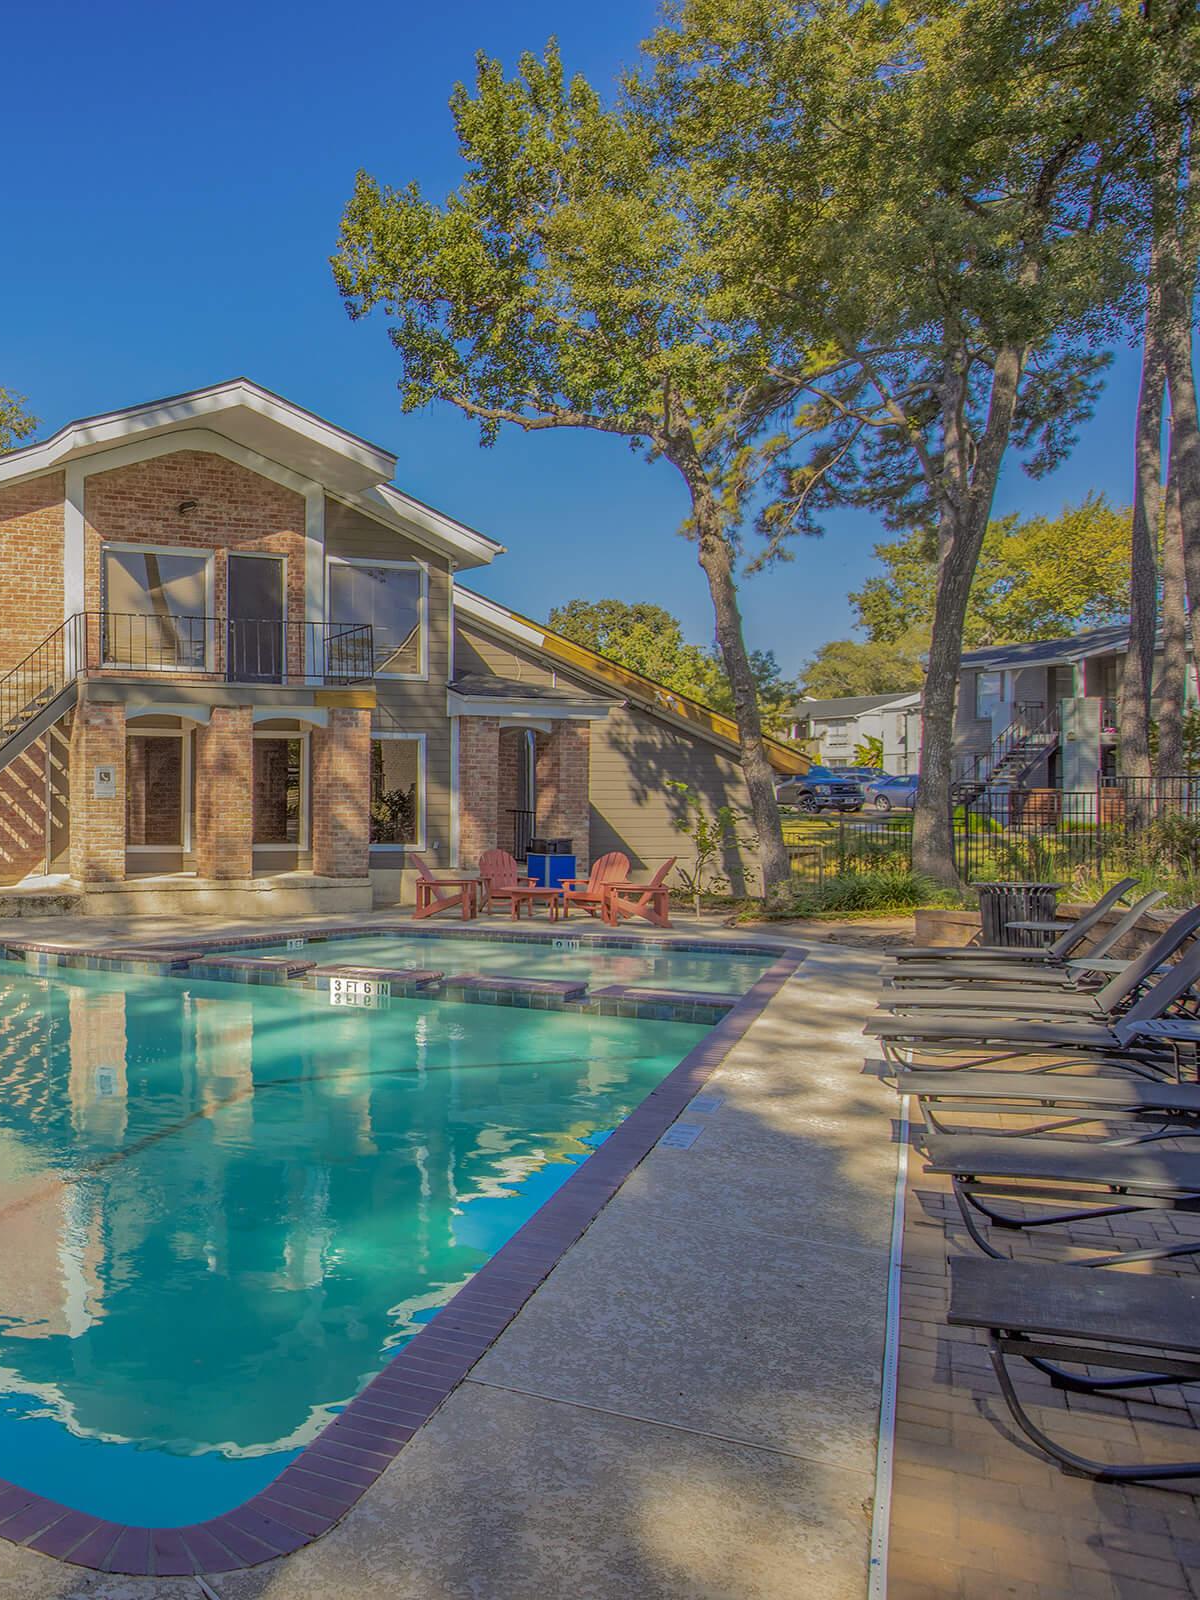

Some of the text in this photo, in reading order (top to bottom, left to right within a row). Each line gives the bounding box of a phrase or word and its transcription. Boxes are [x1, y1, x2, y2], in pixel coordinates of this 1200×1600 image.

[334, 980, 388, 995] 3 FT 6 IN
